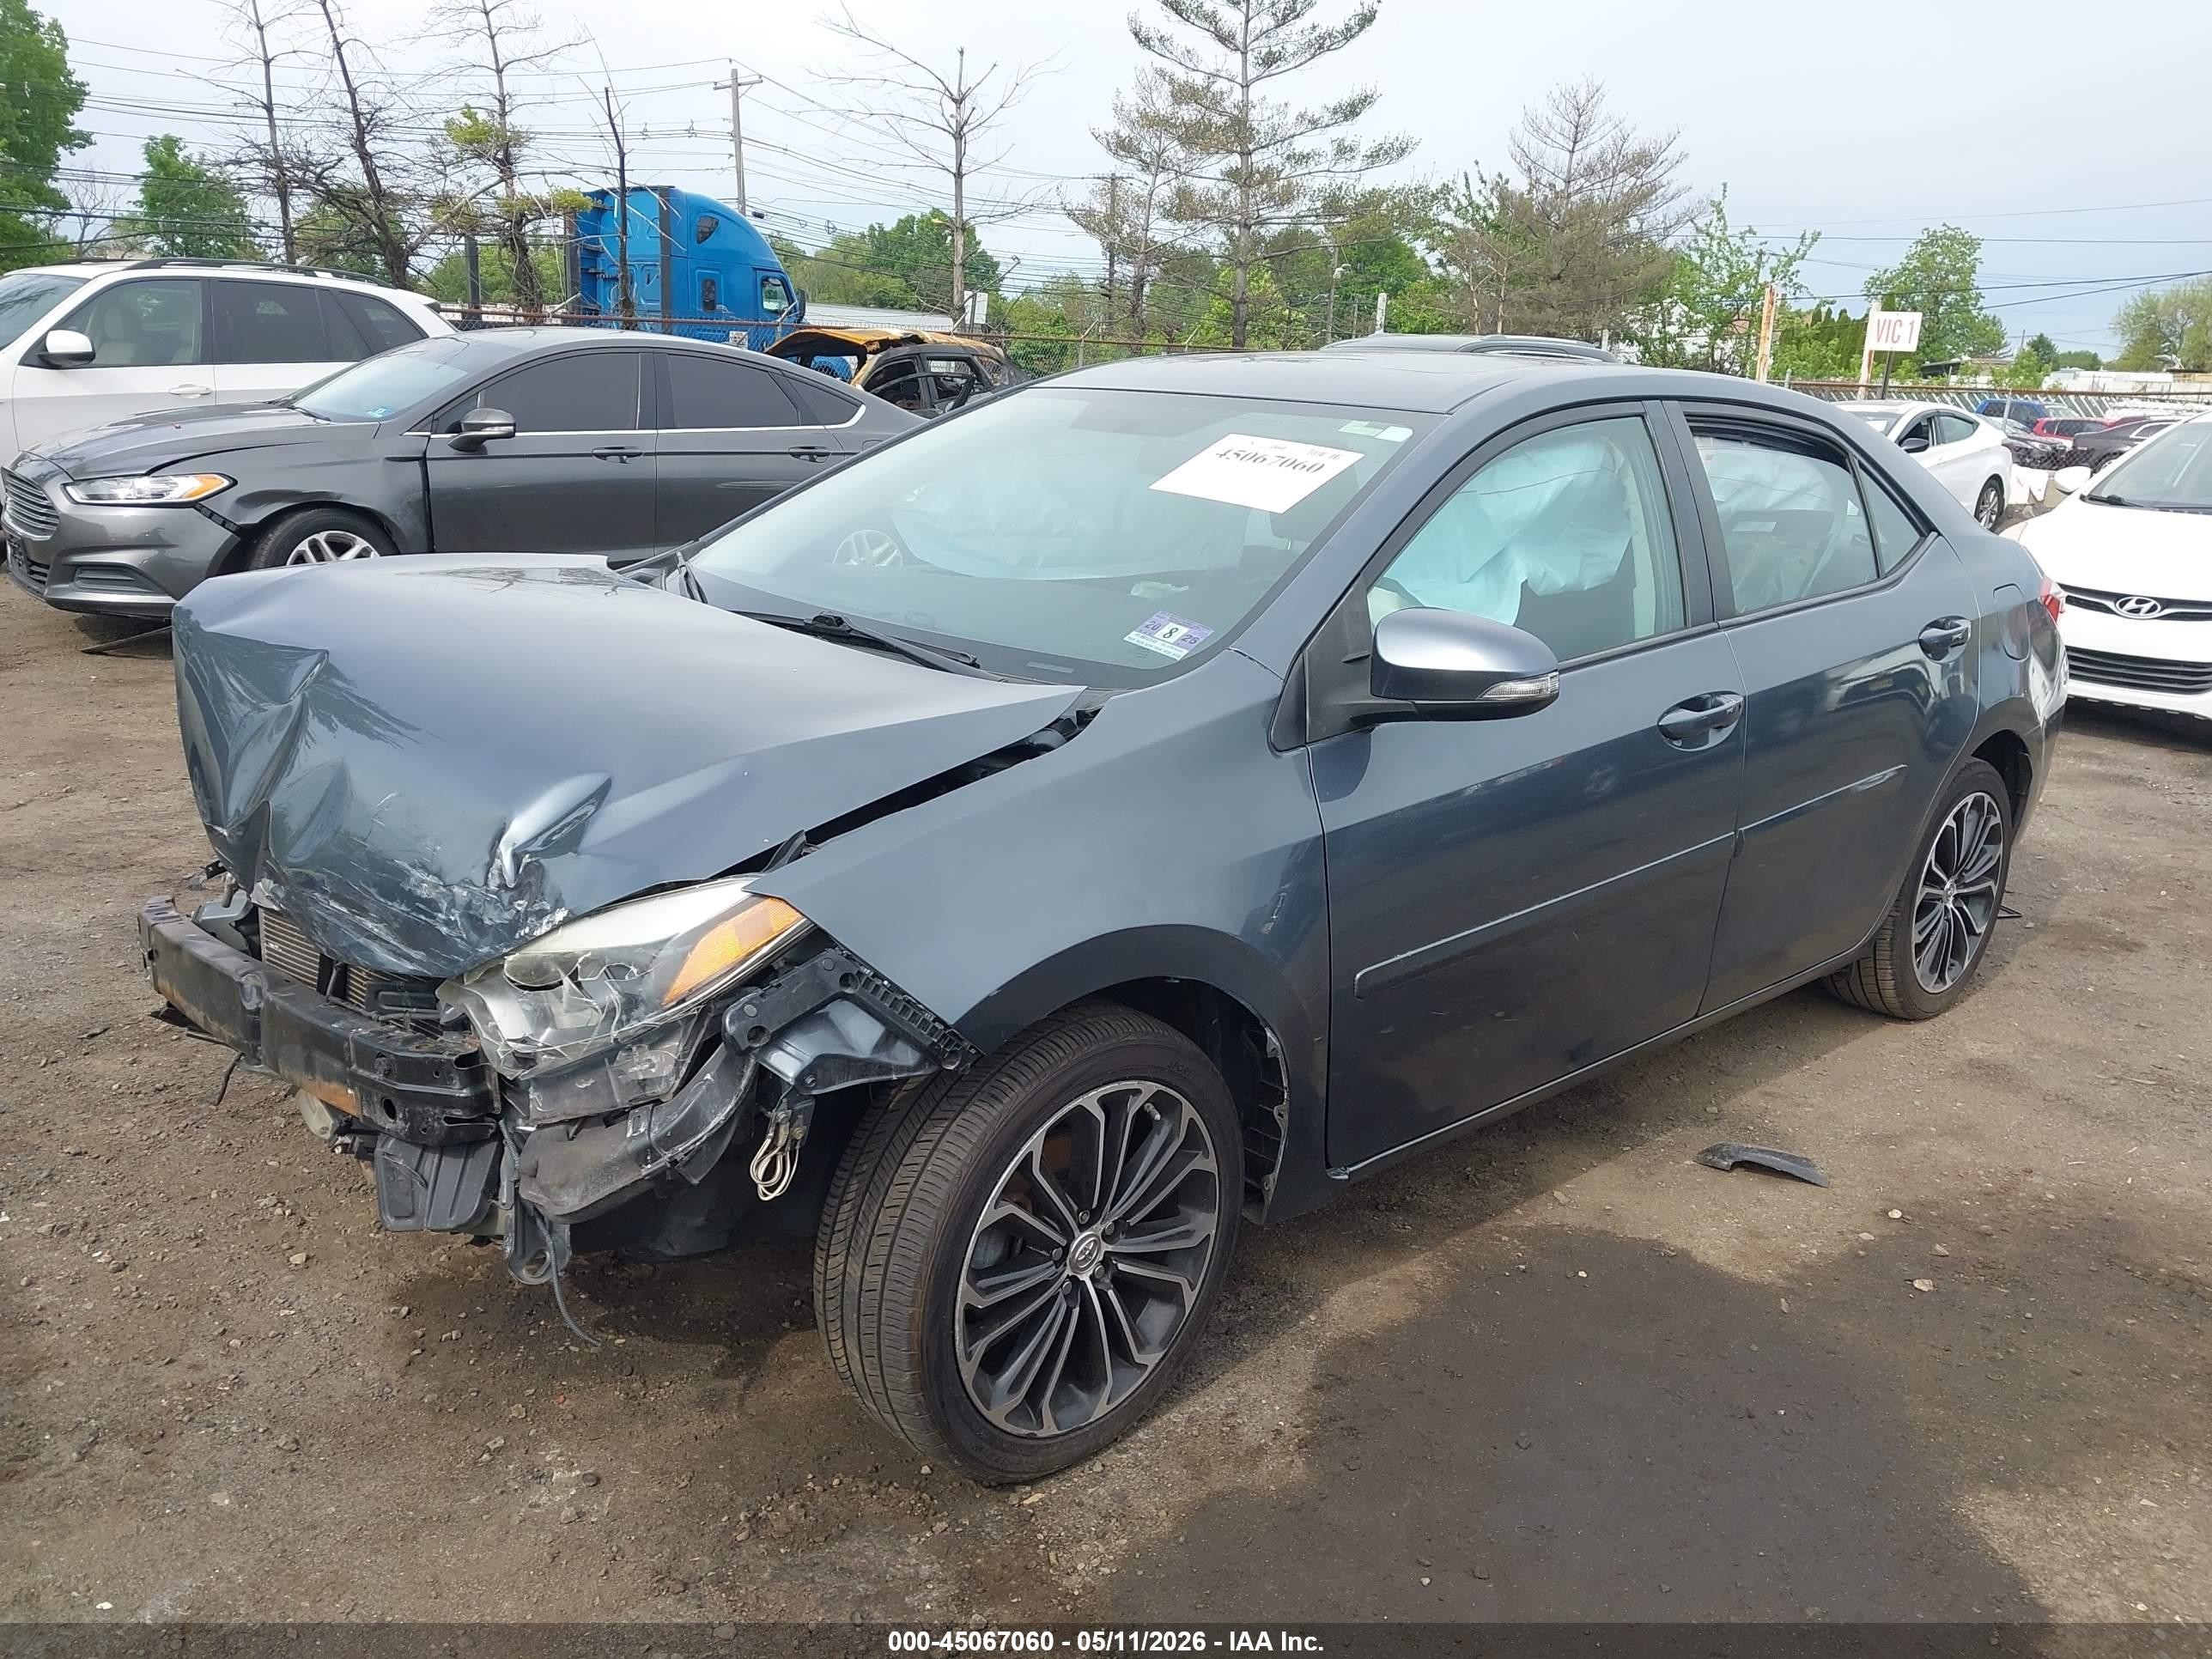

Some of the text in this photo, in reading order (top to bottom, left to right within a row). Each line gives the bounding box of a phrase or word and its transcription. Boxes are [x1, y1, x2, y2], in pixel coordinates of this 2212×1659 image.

[1877, 319, 1915, 343] VIC 1
[1216, 448, 1326, 473] 45067060
[1145, 620, 1162, 631] 20
[1163, 628, 1179, 639] 8
[1181, 635, 1200, 644] 26
